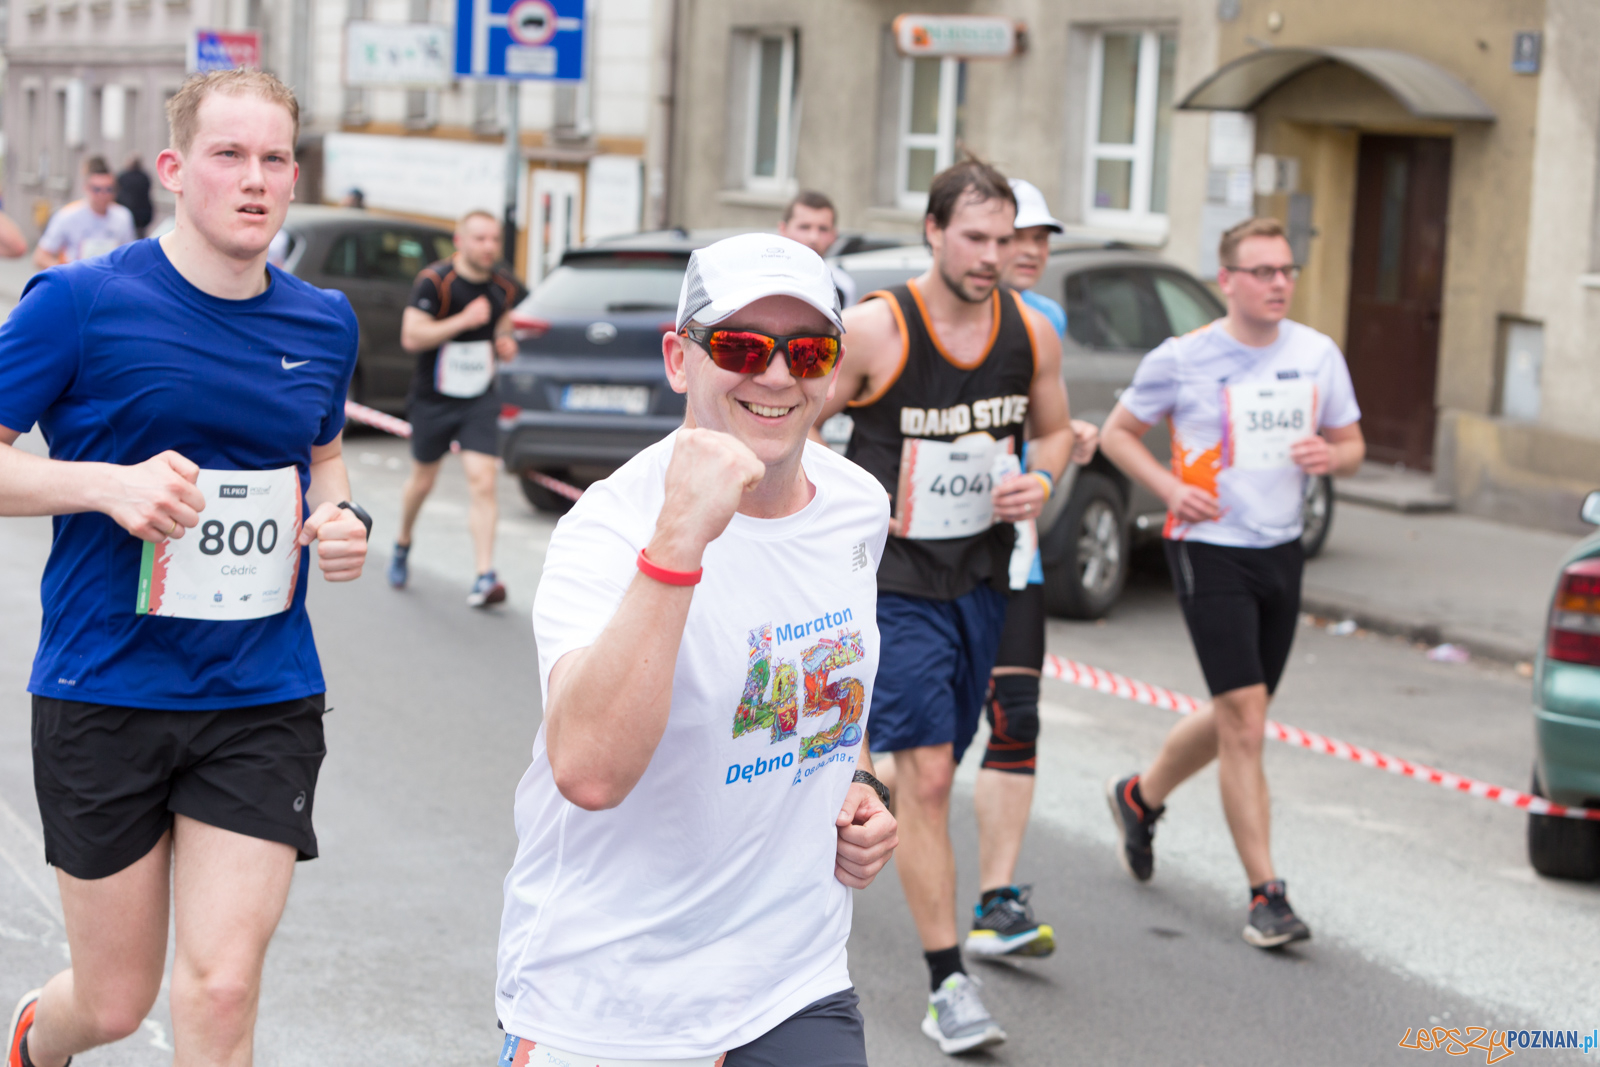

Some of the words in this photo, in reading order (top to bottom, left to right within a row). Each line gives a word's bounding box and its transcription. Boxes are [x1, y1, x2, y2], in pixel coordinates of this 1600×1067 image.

[901, 407, 971, 436] IDAHO
[1246, 409, 1304, 432] 3848
[199, 519, 278, 556] 800
[221, 563, 257, 576] Cédric
[776, 607, 853, 646] Maraton
[725, 752, 794, 785] Dębno
